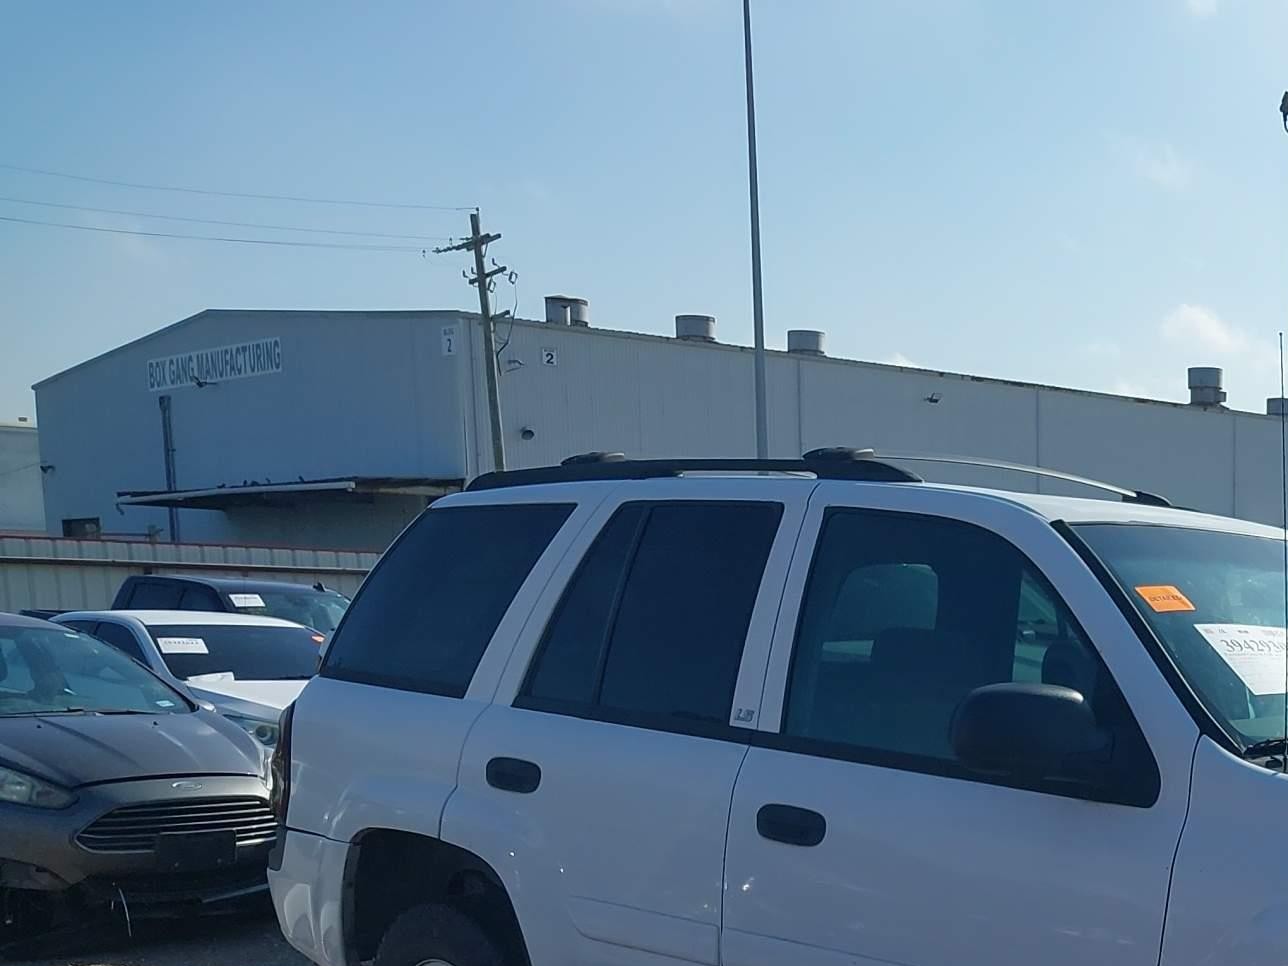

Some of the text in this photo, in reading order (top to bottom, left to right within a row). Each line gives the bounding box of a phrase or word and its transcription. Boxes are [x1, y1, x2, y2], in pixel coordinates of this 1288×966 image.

[446, 338, 453, 353] 2
[148, 339, 281, 388] BOX GANG MANUFACTURING
[545, 352, 555, 366] 2
